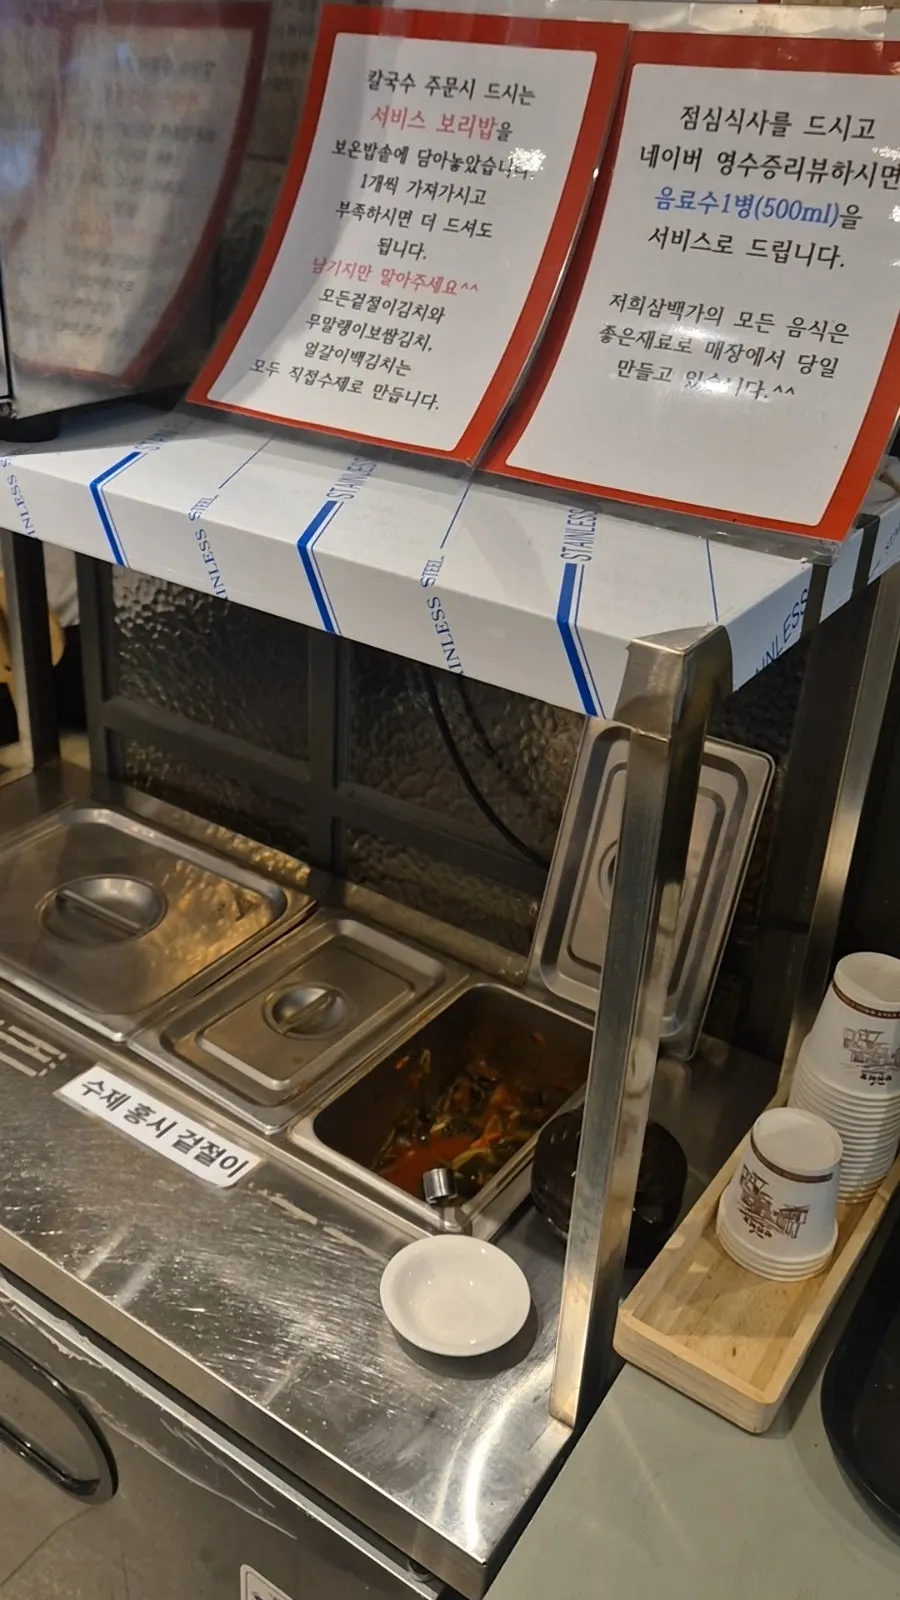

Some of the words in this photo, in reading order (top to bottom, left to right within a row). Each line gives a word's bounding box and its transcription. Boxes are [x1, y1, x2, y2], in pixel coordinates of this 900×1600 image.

[367, 69, 416, 94] 칼국수
[424, 75, 476, 100] 주문시
[484, 83, 536, 105] 드시는
[371, 105, 426, 130] 서비스
[436, 113, 513, 142] 보리밥을
[680, 105, 792, 138] 점심식사를
[803, 114, 875, 142] 드시고
[331, 140, 409, 165] 보온밥솥에
[640, 144, 703, 173] 네이버
[716, 150, 900, 190] 영수증리뷰하시면
[360, 173, 399, 196] 1개씩
[406, 179, 487, 205] 가져가시고
[335, 200, 413, 228] 부족하시면
[420, 213, 437, 232] 더
[443, 217, 493, 238] 드셔도
[655, 186, 863, 231] 음료수1병(500ml)을
[377, 237, 427, 261] 됩니다.
[648, 226, 733, 255] 서비스로
[746, 239, 846, 271] 드립니다.
[312, 257, 373, 283] 남기지만
[318, 287, 446, 325] 모든겉절이김치와
[609, 293, 725, 327] 저희삼백가의
[733, 311, 776, 334] 모든
[786, 316, 850, 345] 음식은
[304, 341, 412, 377] 얼갈이백김치는
[600, 324, 693, 355] 좋은재료로
[704, 340, 786, 371] 매장에서
[797, 354, 839, 379] 당일
[250, 359, 280, 376] 모두
[288, 365, 364, 394] 직접수제로
[372, 383, 440, 411] 만듭니다.
[617, 359, 673, 383] 만들고
[82, 1080, 131, 1112] 수제
[123, 1102, 178, 1139] 홍시
